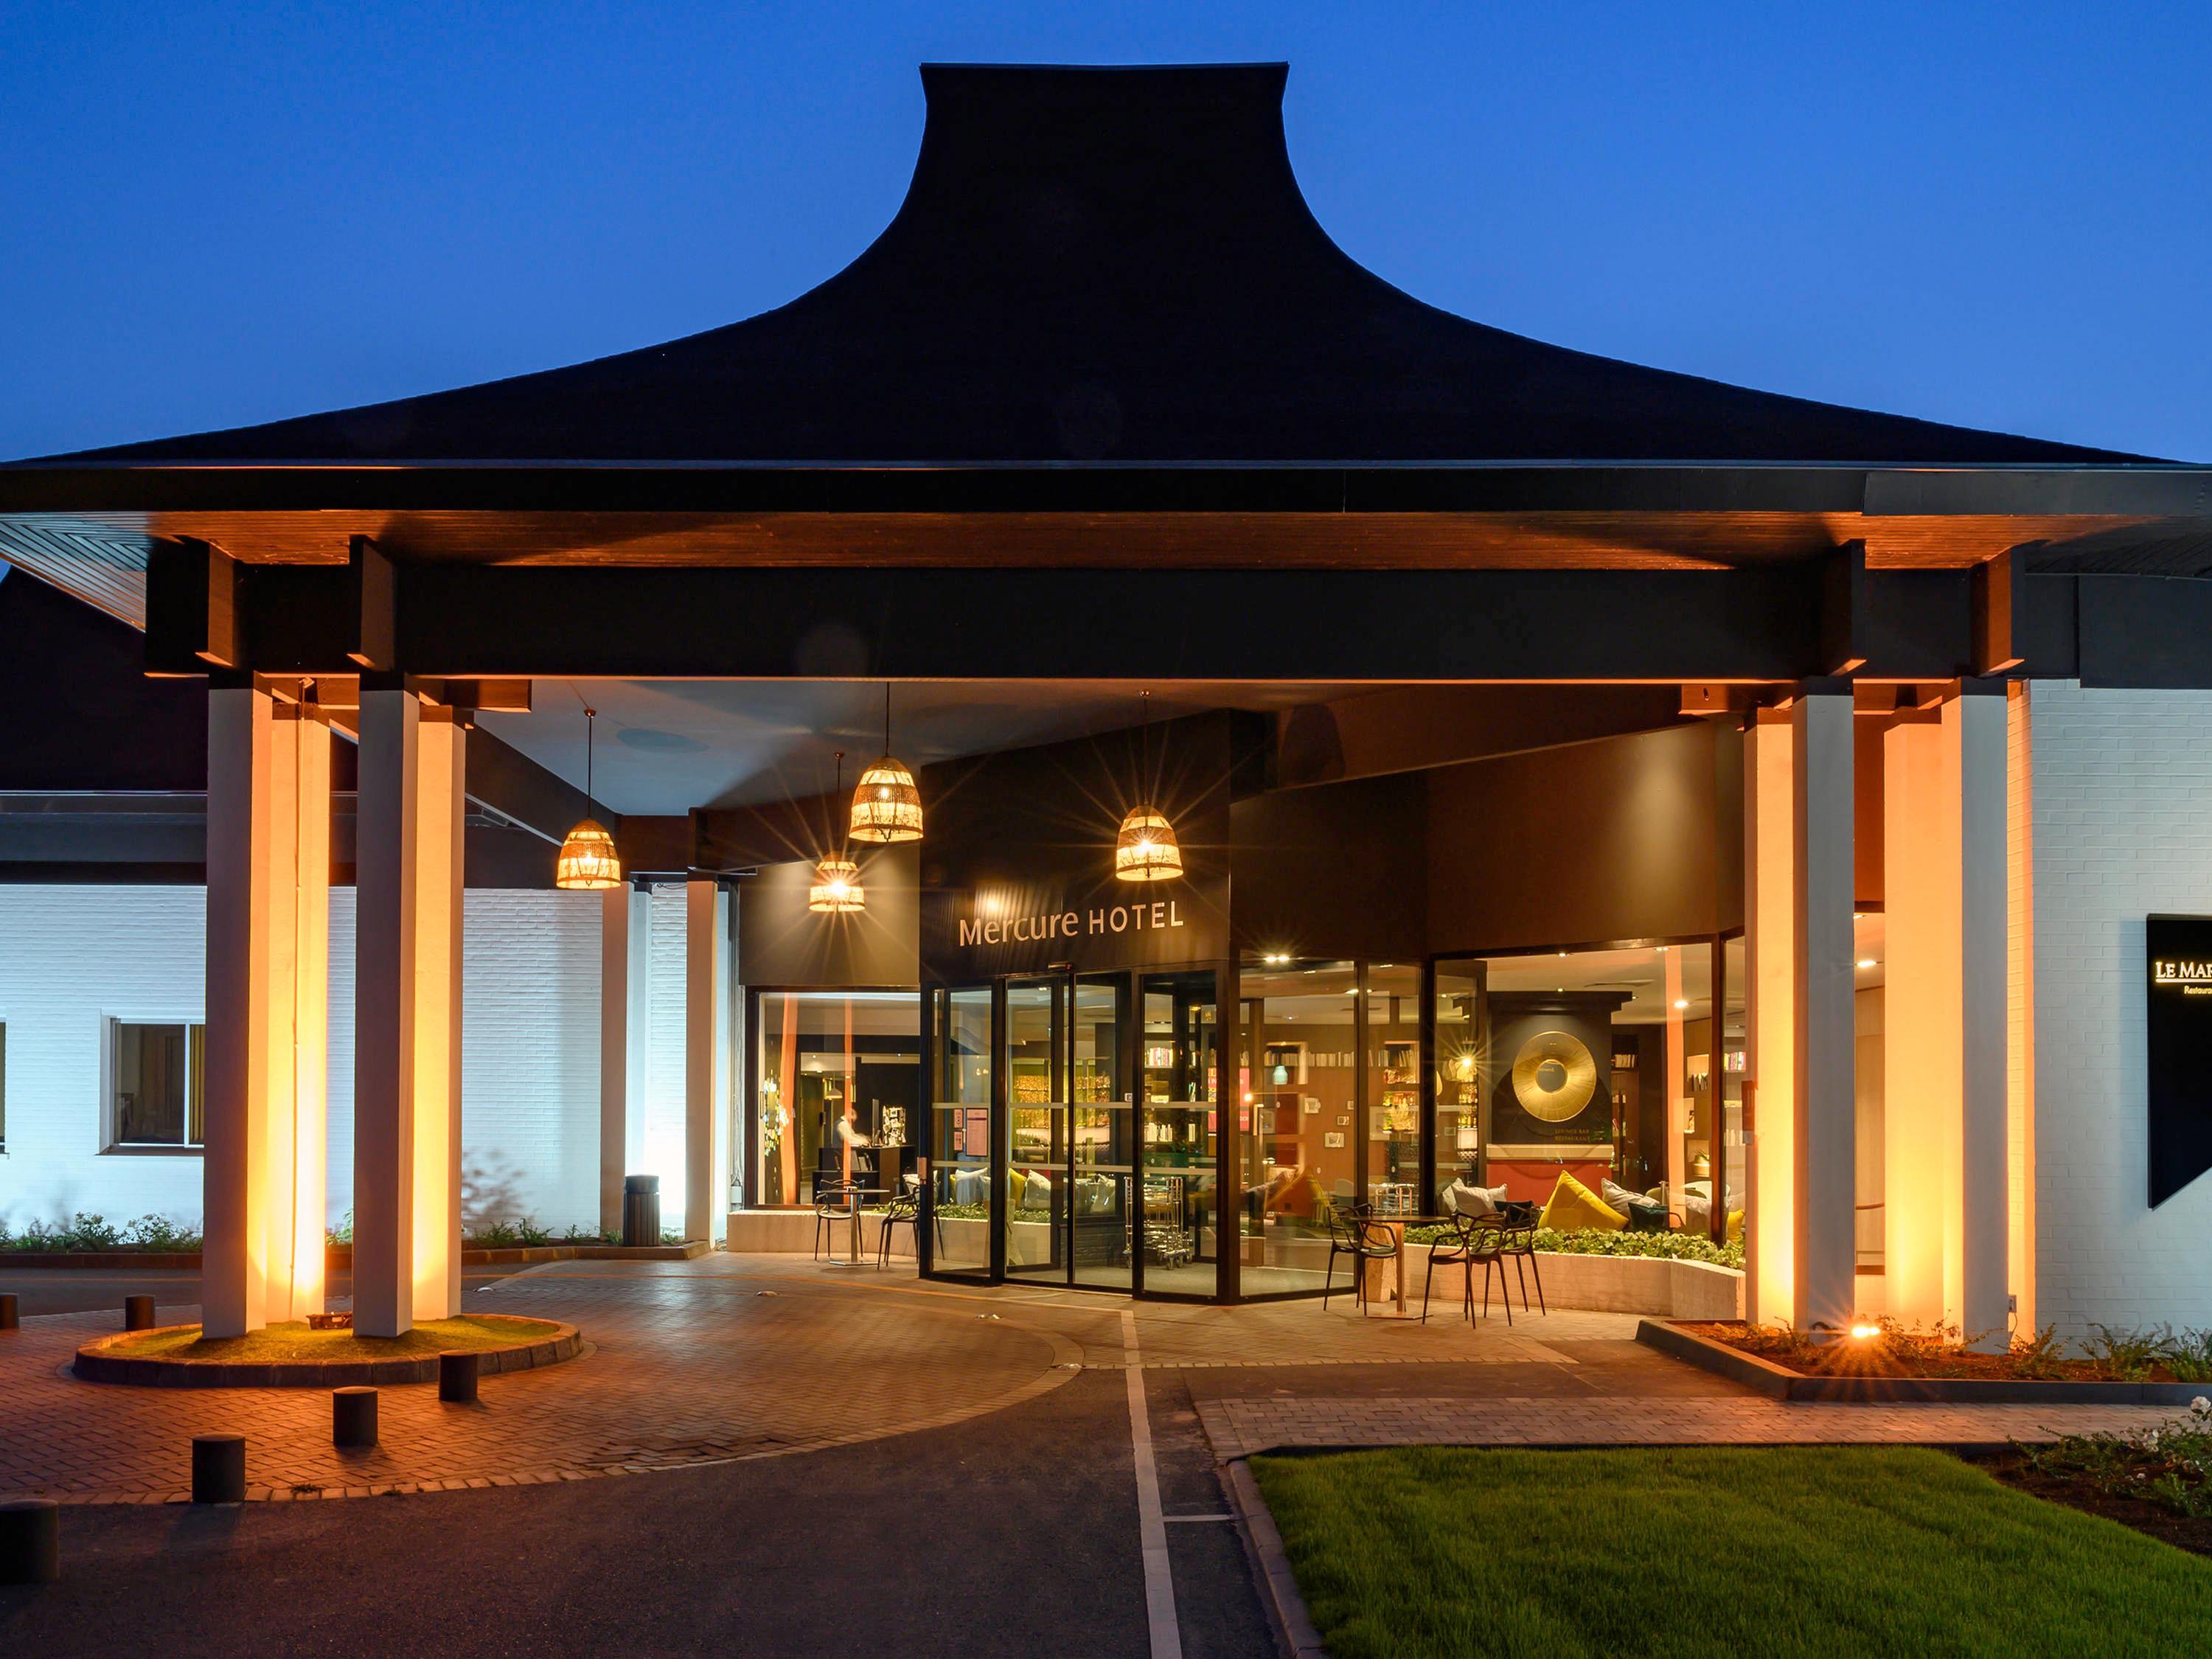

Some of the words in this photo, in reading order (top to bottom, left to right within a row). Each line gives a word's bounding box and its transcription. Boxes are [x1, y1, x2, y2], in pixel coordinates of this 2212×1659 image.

[959, 912, 1079, 946] Mercure
[1089, 901, 1183, 934] HOTEL
[2155, 961, 2176, 978] LE
